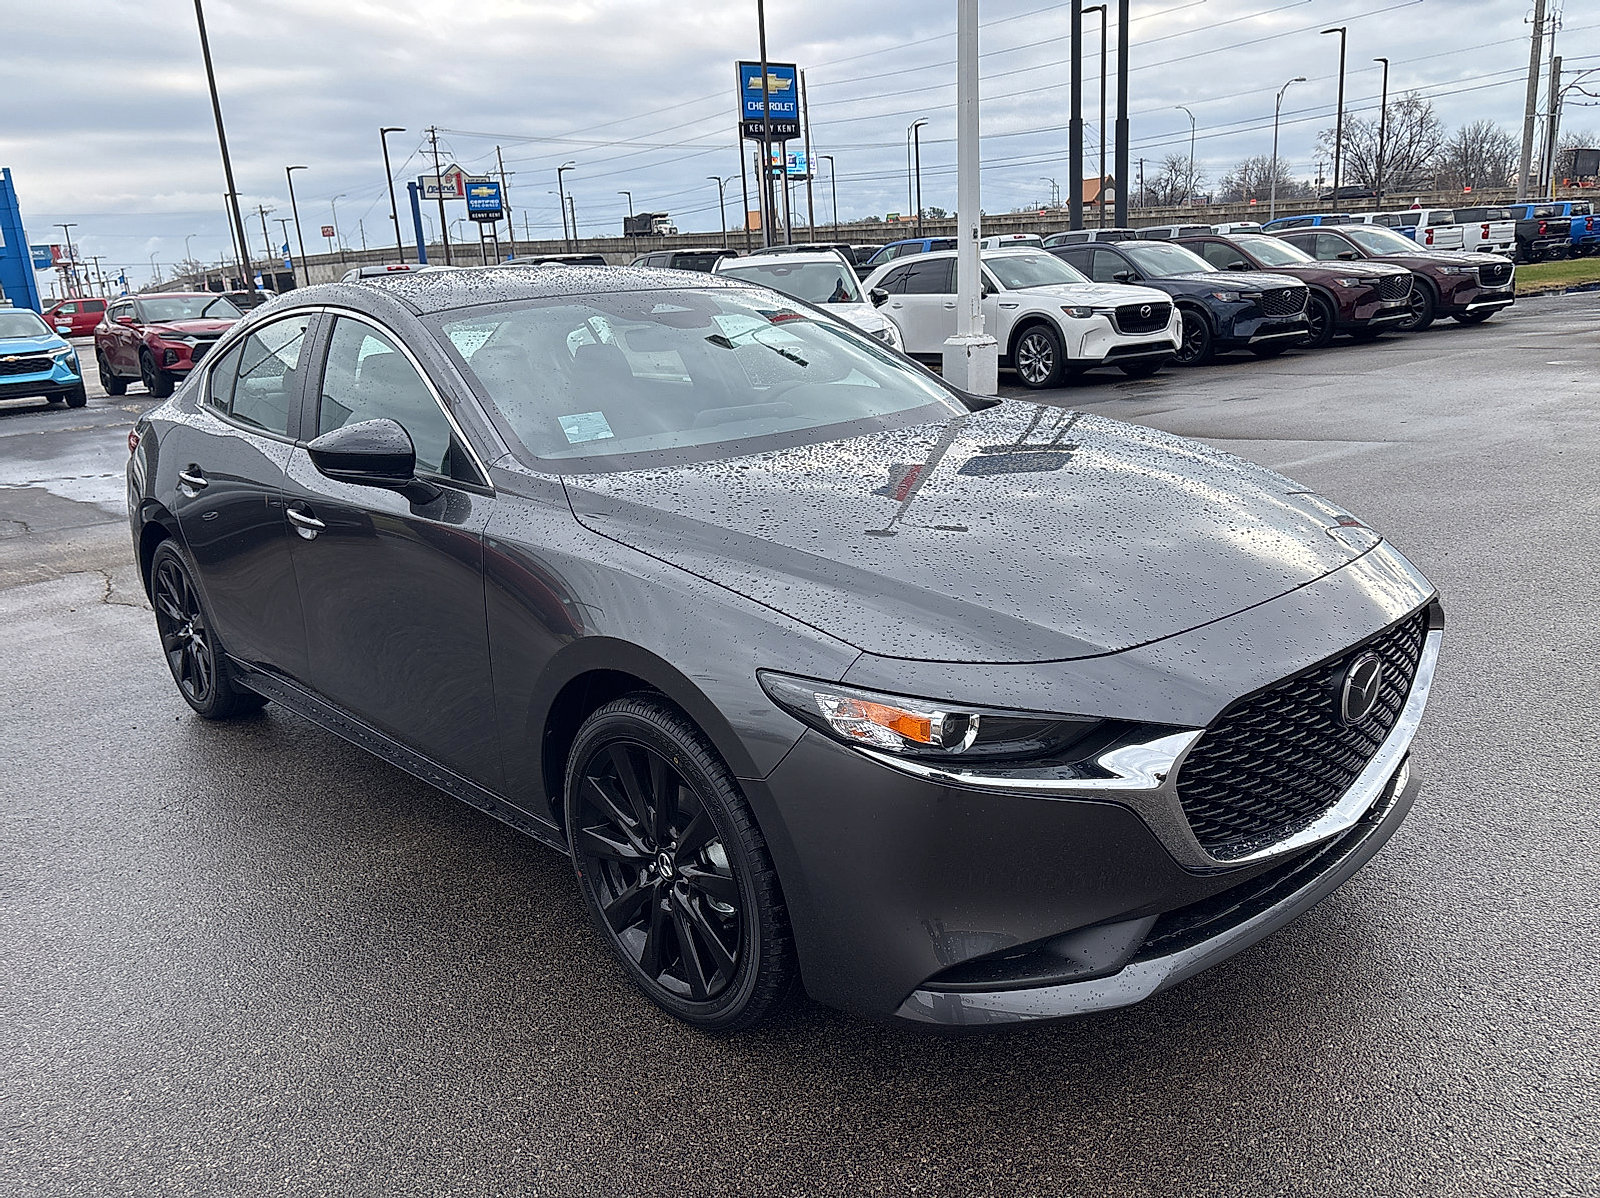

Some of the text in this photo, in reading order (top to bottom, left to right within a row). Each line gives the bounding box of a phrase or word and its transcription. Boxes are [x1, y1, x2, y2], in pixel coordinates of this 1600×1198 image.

[747, 101, 794, 111] CHEROLET
[749, 123, 796, 133] KENY KENT
